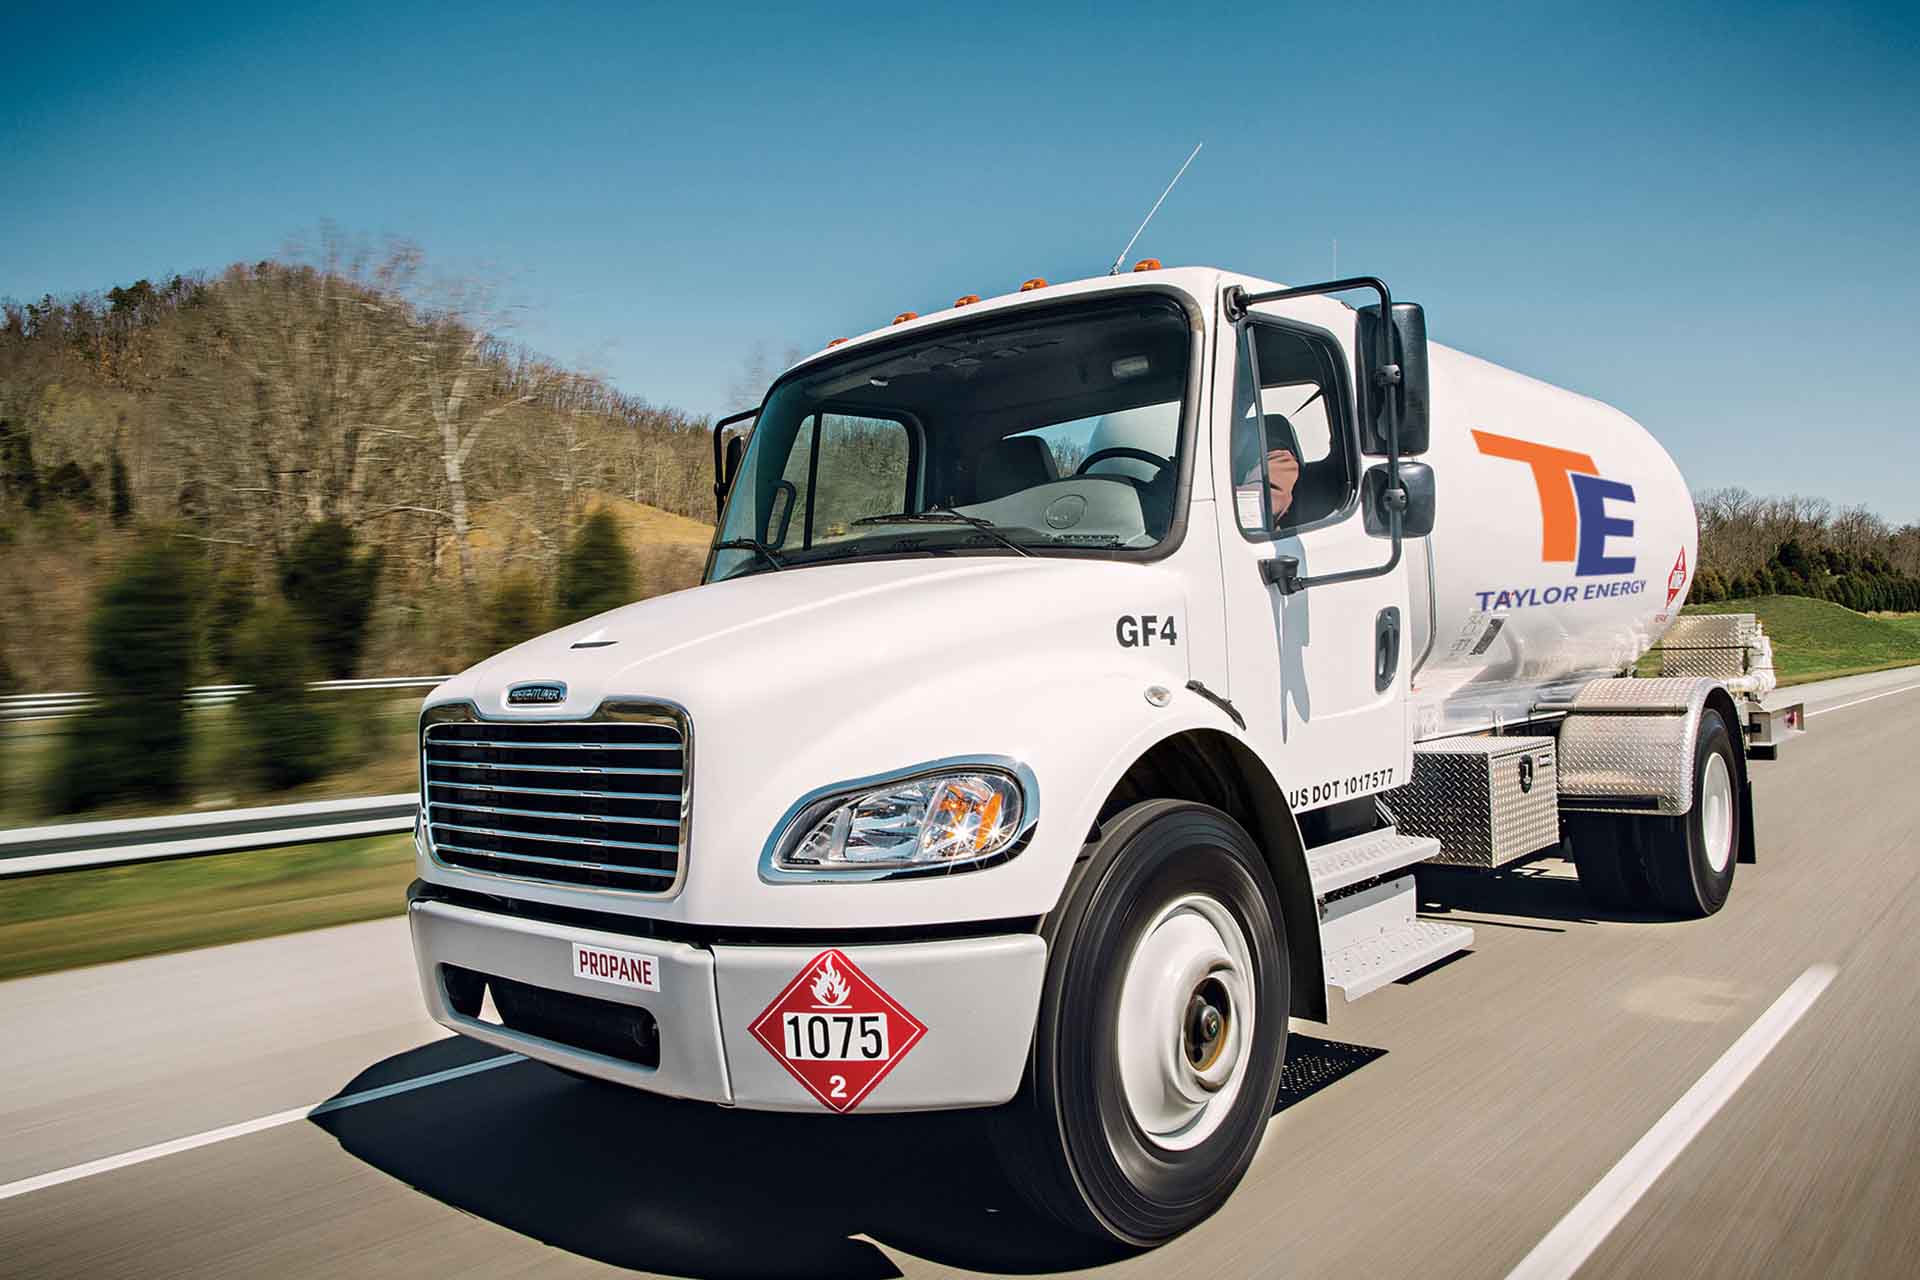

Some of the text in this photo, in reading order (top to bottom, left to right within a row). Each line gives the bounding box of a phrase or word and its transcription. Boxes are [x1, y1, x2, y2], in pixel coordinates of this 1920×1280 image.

[1471, 429, 1636, 577] TE
[1475, 580, 1647, 612] TAYLOR ENERGY
[1116, 615, 1177, 648] GF4
[1290, 768, 1394, 809] US DOT 1017577
[579, 949, 652, 986] PROPANE
[786, 1014, 883, 1059] 1075
[828, 1074, 847, 1098] 2
